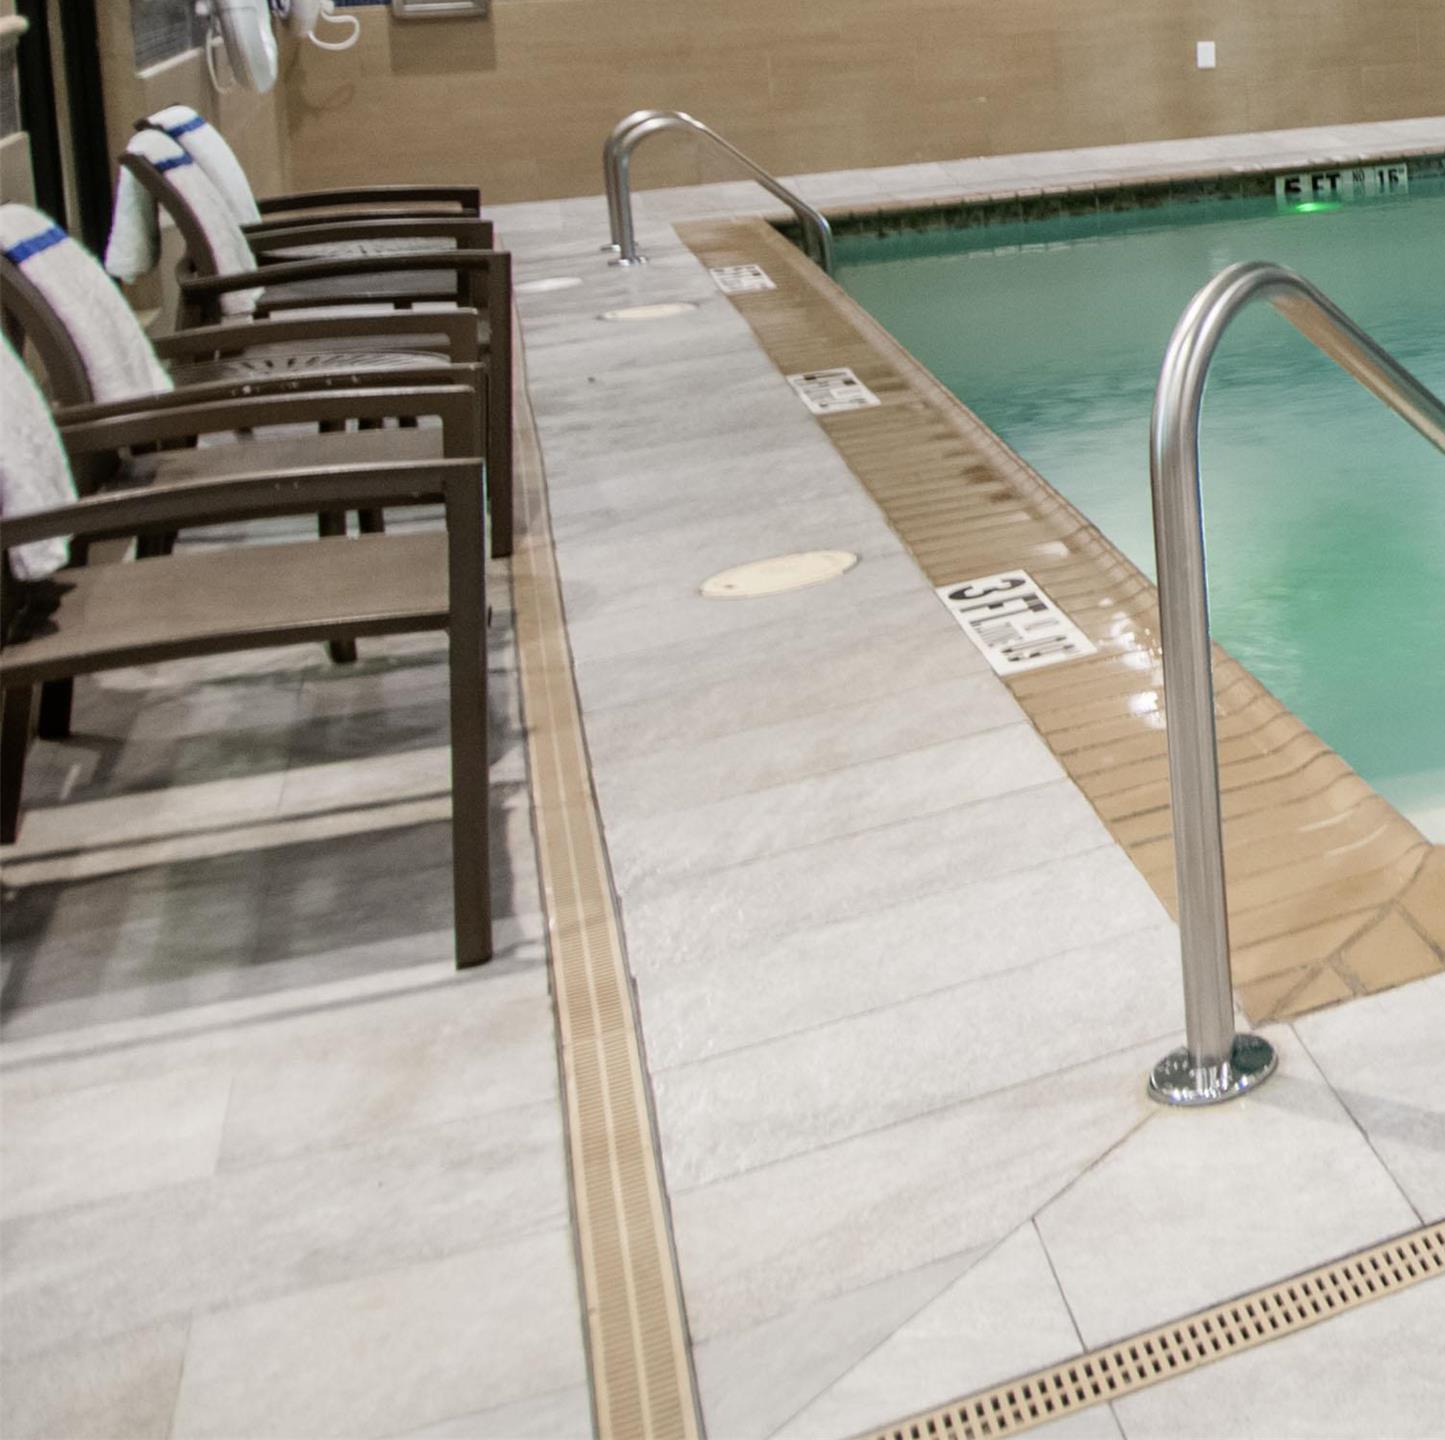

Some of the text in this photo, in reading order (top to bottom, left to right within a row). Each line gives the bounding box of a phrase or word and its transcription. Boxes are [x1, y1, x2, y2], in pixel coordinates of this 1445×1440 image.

[1312, 171, 1341, 191] FT
[949, 579, 1026, 600] 3
[960, 592, 1048, 627] FT
